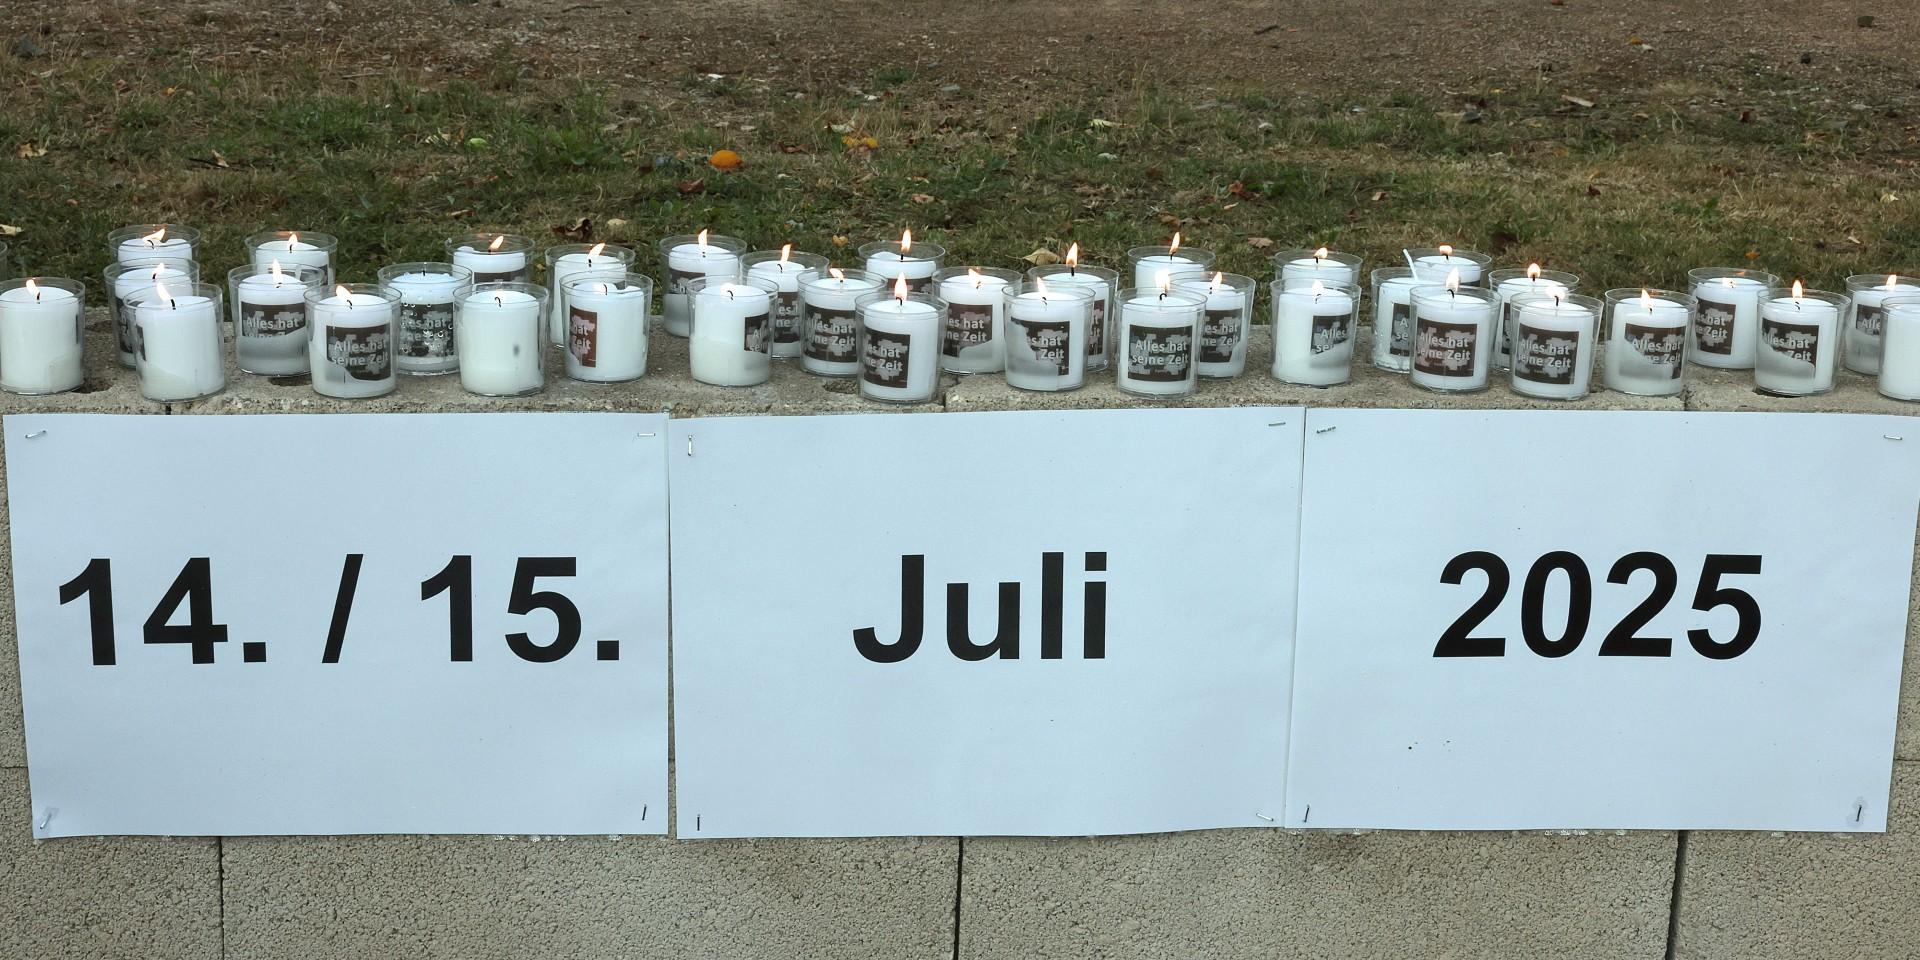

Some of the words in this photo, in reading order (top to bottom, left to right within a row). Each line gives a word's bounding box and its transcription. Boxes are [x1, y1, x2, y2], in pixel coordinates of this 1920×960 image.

[246, 316, 274, 330] Alles
[278, 317, 300, 330] hat
[963, 317, 984, 330] hat
[1706, 315, 1726, 327] hat
[572, 323, 589, 336] hat
[832, 321, 854, 335] hat
[1220, 323, 1238, 335] hat
[1320, 328, 1347, 341] Alles
[1705, 326, 1728, 339] Zeit
[831, 335, 856, 347] Zeit
[962, 330, 987, 343] Zeit
[1040, 334, 1062, 348] hat
[1220, 335, 1240, 347] Zeit
[1420, 331, 1445, 347] Alles
[1447, 335, 1470, 348] hat
[1788, 337, 1811, 349] hat
[334, 340, 366, 353] Alles
[369, 338, 388, 351] hat
[880, 345, 901, 358] hat
[1135, 338, 1165, 351] Alles
[1168, 340, 1187, 353] hat
[1520, 338, 1545, 353] Alles
[1548, 343, 1570, 356] hat
[1632, 337, 1664, 352] Alles
[1665, 340, 1681, 353] hat
[331, 353, 366, 367] seine
[369, 351, 389, 365] Zeit
[1040, 347, 1065, 360] Zeit
[1131, 353, 1165, 367] seine
[1168, 353, 1189, 365] Zeit
[1446, 349, 1471, 361] Zeit
[1663, 353, 1682, 365] Zeit
[1788, 350, 1812, 362] Zeit
[879, 358, 903, 372] Zeit
[1547, 355, 1572, 368] Zeit
[58, 557, 267, 666] 14.
[322, 553, 364, 664] /
[420, 554, 620, 663] 15.
[852, 551, 1107, 664] Juli
[1432, 550, 1764, 660] 2025
